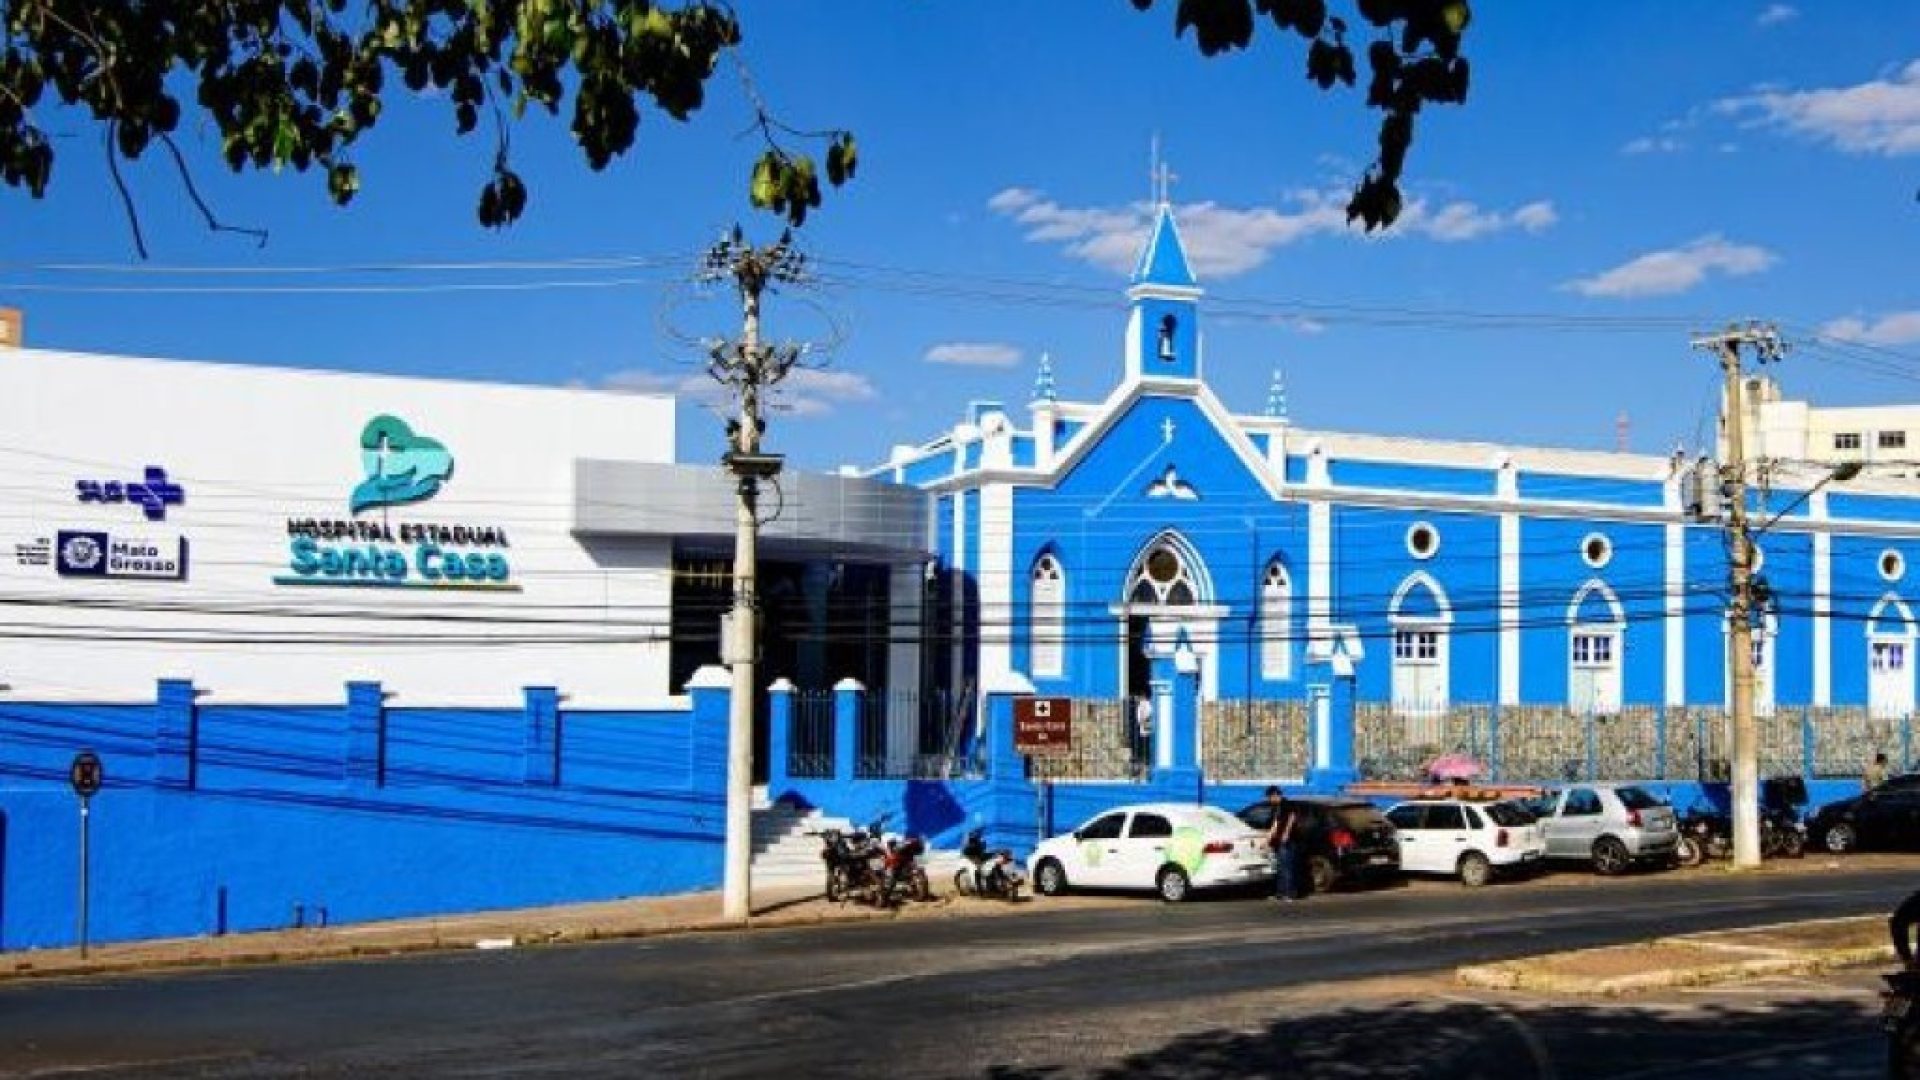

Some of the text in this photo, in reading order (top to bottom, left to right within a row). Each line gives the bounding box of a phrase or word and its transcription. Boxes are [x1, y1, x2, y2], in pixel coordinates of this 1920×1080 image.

[288, 518, 509, 547] HOSPITAL ESTADUAL
[112, 543, 159, 556] Mato
[291, 534, 509, 581] Santa Casa
[110, 557, 175, 572] Grosso
